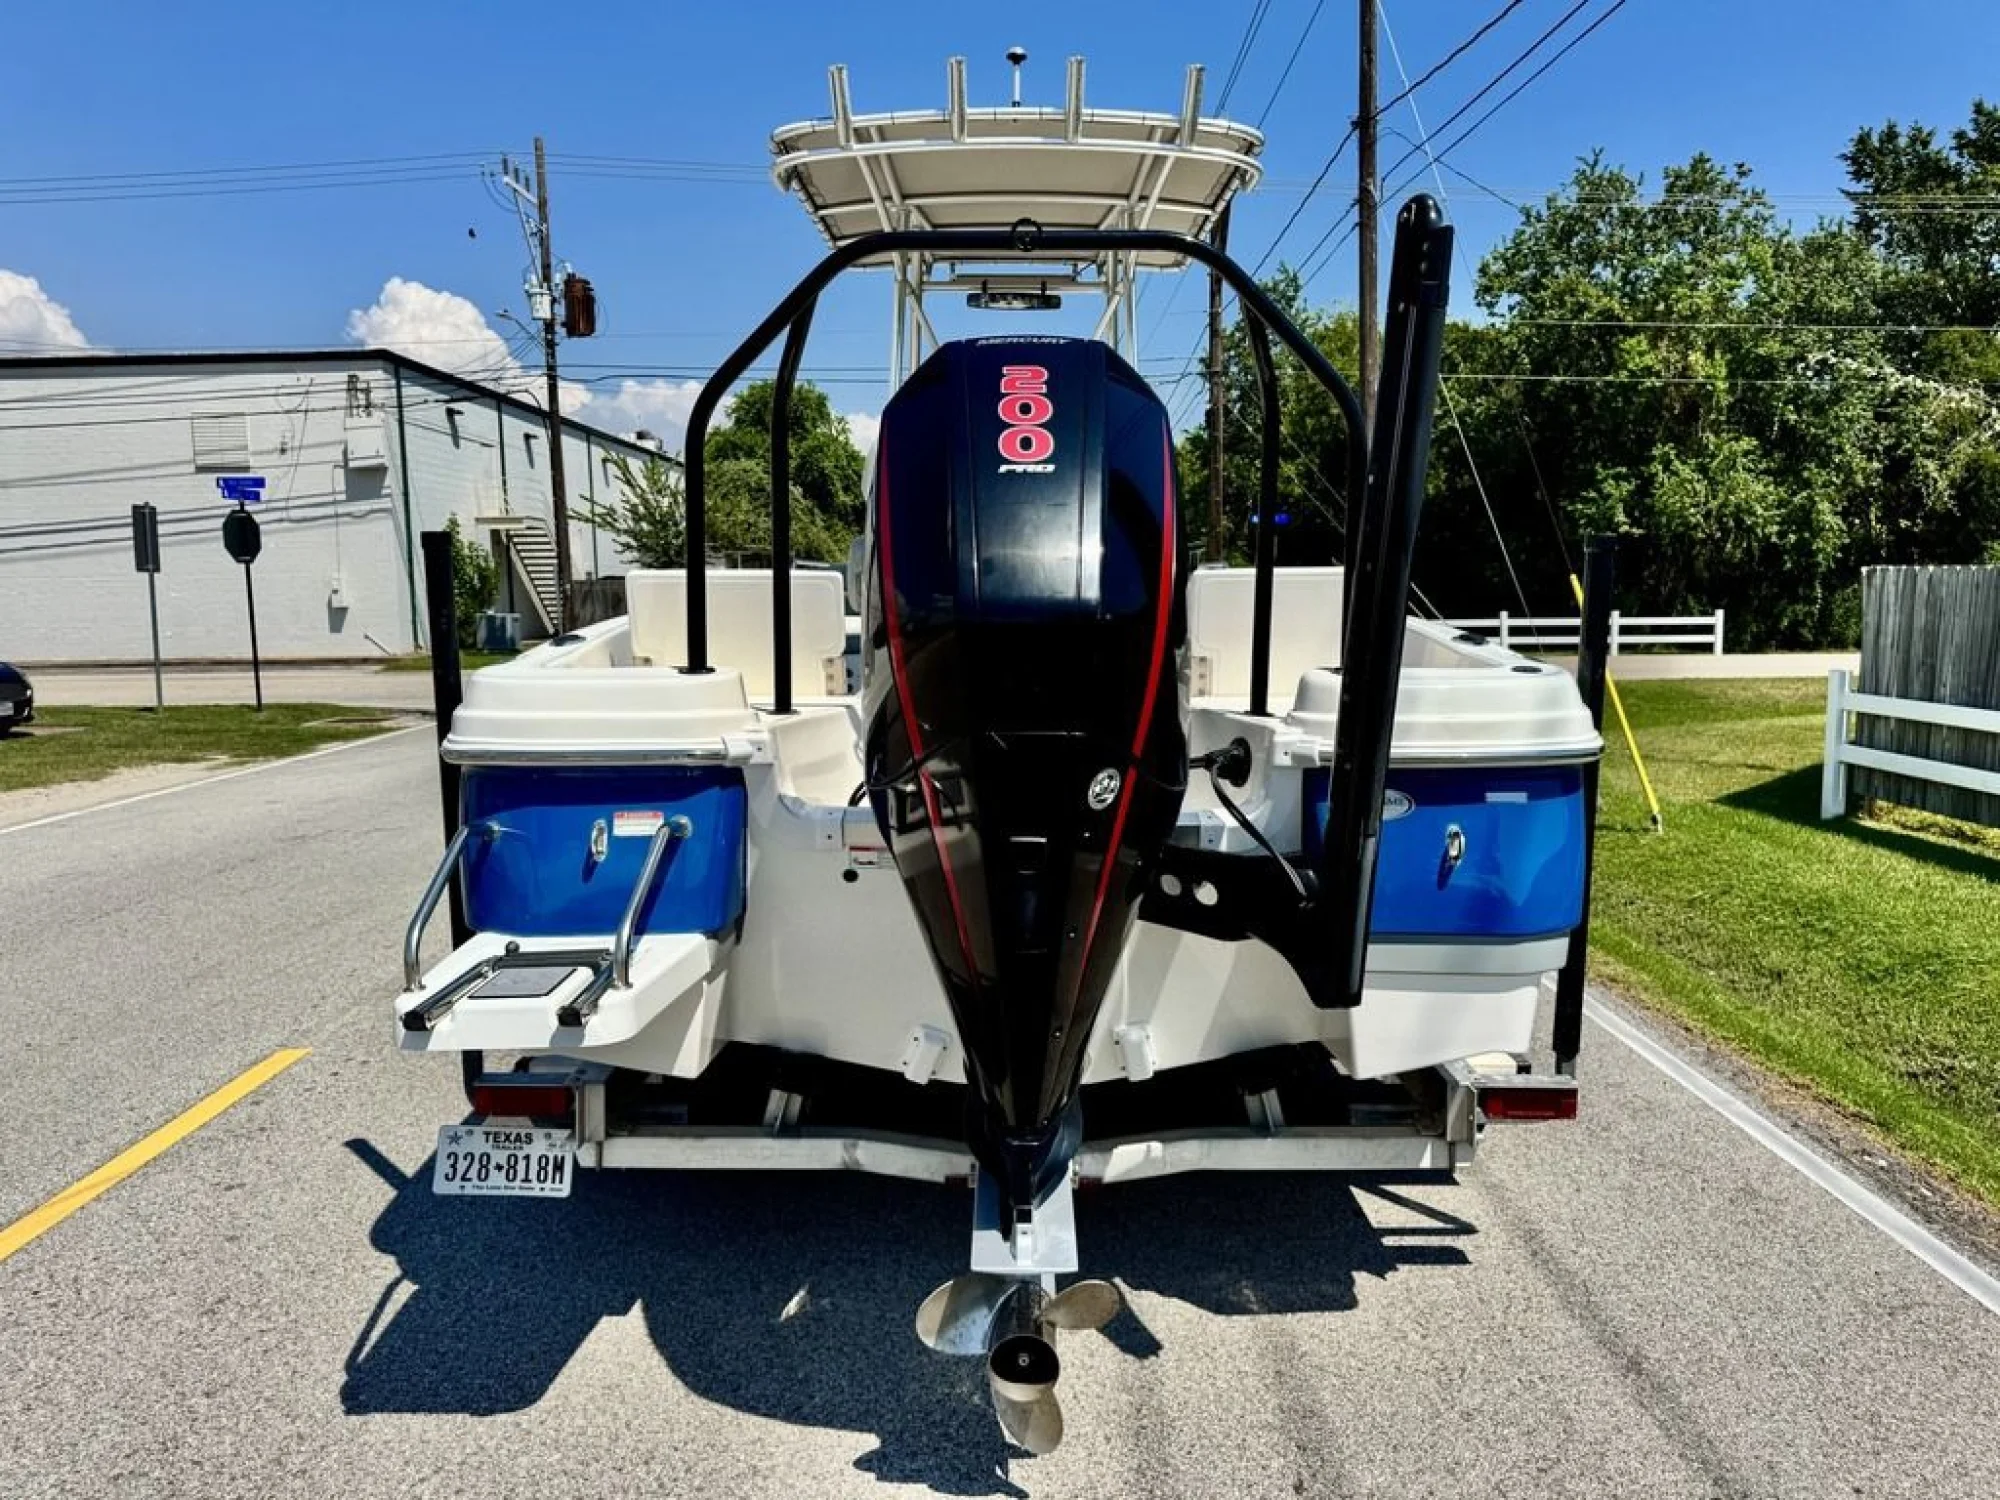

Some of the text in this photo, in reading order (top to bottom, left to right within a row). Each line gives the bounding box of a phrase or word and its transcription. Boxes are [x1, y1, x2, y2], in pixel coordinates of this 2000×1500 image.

[998, 365, 1055, 462] 200
[998, 464, 1055, 473] PRO
[483, 1130, 534, 1145] TEXAS
